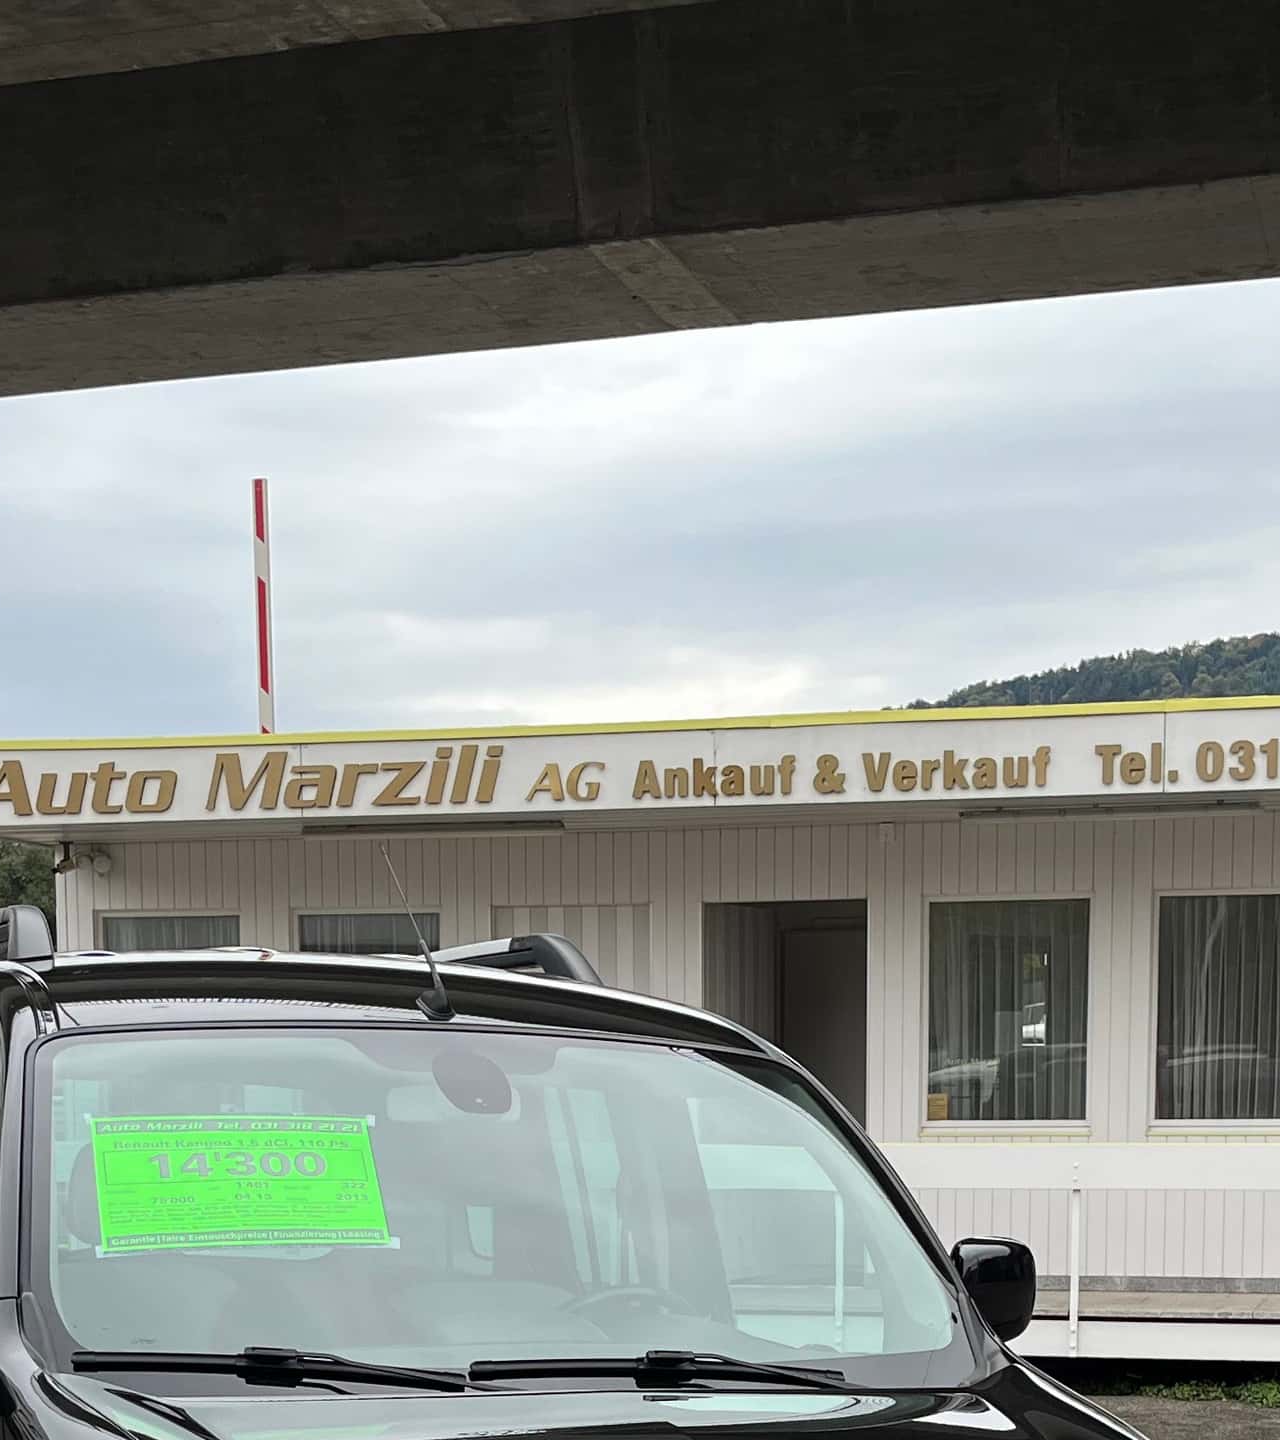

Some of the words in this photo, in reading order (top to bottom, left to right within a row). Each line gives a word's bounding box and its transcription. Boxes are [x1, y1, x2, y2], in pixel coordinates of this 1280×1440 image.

[205, 745, 504, 811] Marzili
[525, 761, 605, 801] AG
[632, 755, 796, 799] Ankauf
[813, 754, 846, 794] &
[862, 745, 1051, 792] Verkauf
[1095, 742, 1179, 785] Tel.
[1195, 738, 1279, 782] 031
[102, 1123, 140, 1133] Auto
[147, 1121, 202, 1131] Marzili
[148, 1151, 327, 1179] 14'300
